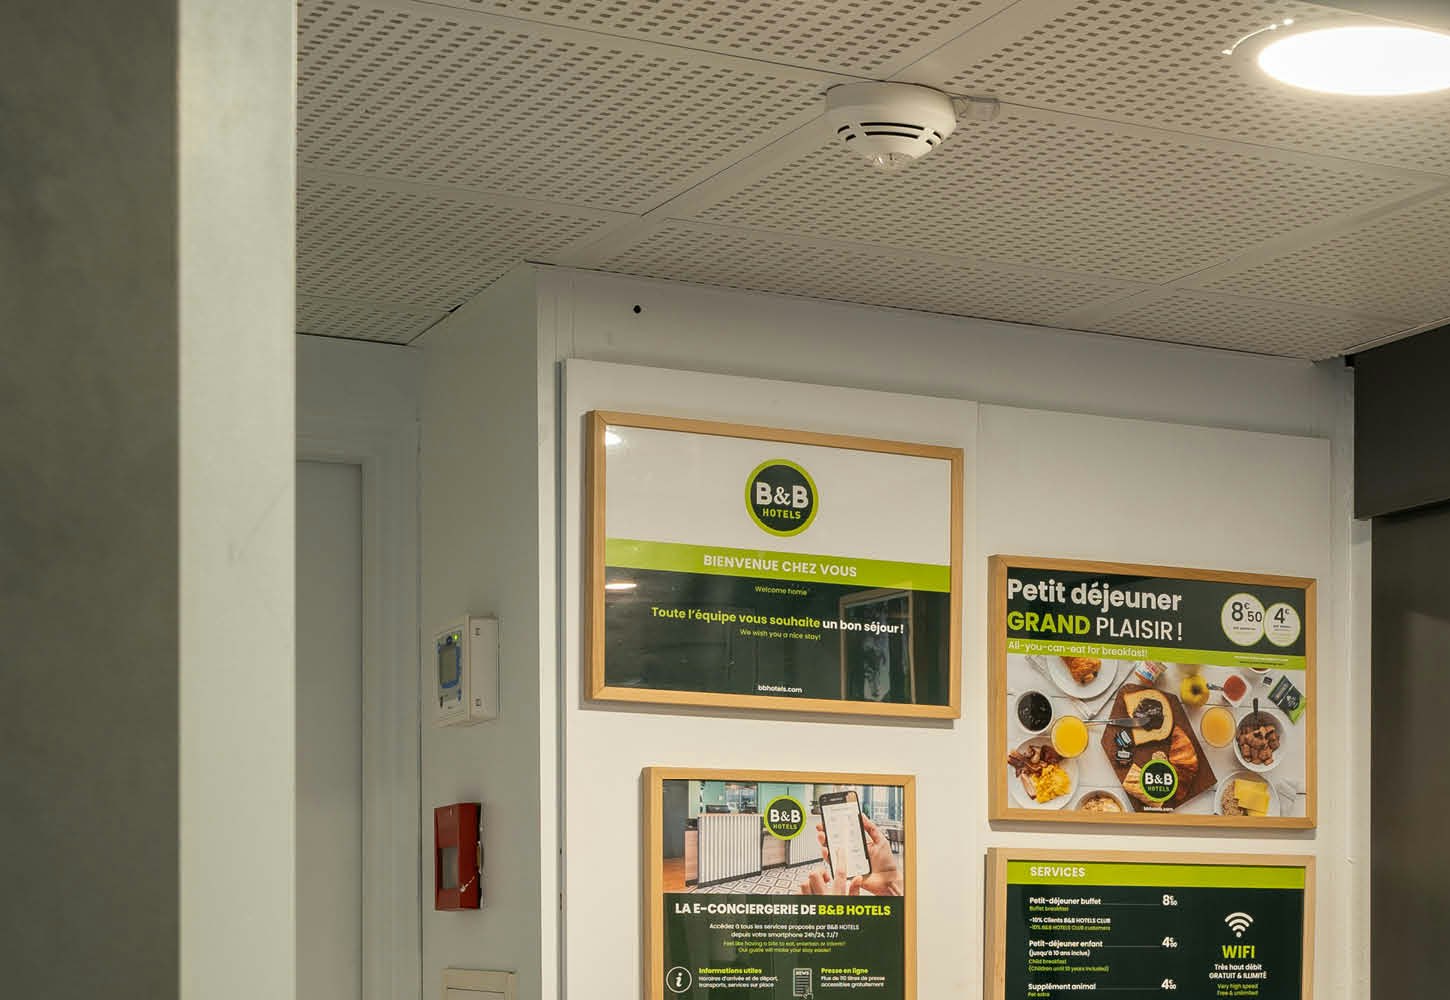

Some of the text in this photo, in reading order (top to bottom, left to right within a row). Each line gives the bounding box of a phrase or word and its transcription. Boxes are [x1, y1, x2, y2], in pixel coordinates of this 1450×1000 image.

[756, 482, 808, 509] B&B
[762, 508, 800, 519] HOTELS
[703, 554, 856, 577] BIENVENUE CHEZ VOUS
[755, 585, 806, 596] Welcome home
[1008, 577, 1180, 614] Petit déjeuner
[651, 606, 685, 619] Toute
[688, 609, 735, 625] l'équipe
[739, 614, 766, 624] vous
[769, 616, 819, 628] souhaite
[822, 620, 837, 629] un
[840, 619, 861, 631] bon
[1008, 611, 1089, 635] GRAND
[1096, 616, 1171, 640] PLAISIR
[805, 633, 820, 641] stay!
[1008, 640, 1085, 654] All-you-can-eat
[1087, 645, 1100, 654] for
[758, 684, 802, 693] bbhotels.com
[1145, 772, 1173, 785] B&B
[770, 809, 801, 824] B&B
[1030, 865, 1085, 877] SERVICES
[1029, 896, 1079, 905] Petit-déjeuner
[675, 903, 890, 915] LA E-CONCIERGERIE DE B&B HOTELS
[1028, 940, 1078, 948] Petit-déjeuner
[1071, 949, 1090, 957] inclus)
[1222, 945, 1255, 958] WIFI
[1028, 983, 1070, 991] Supplément
